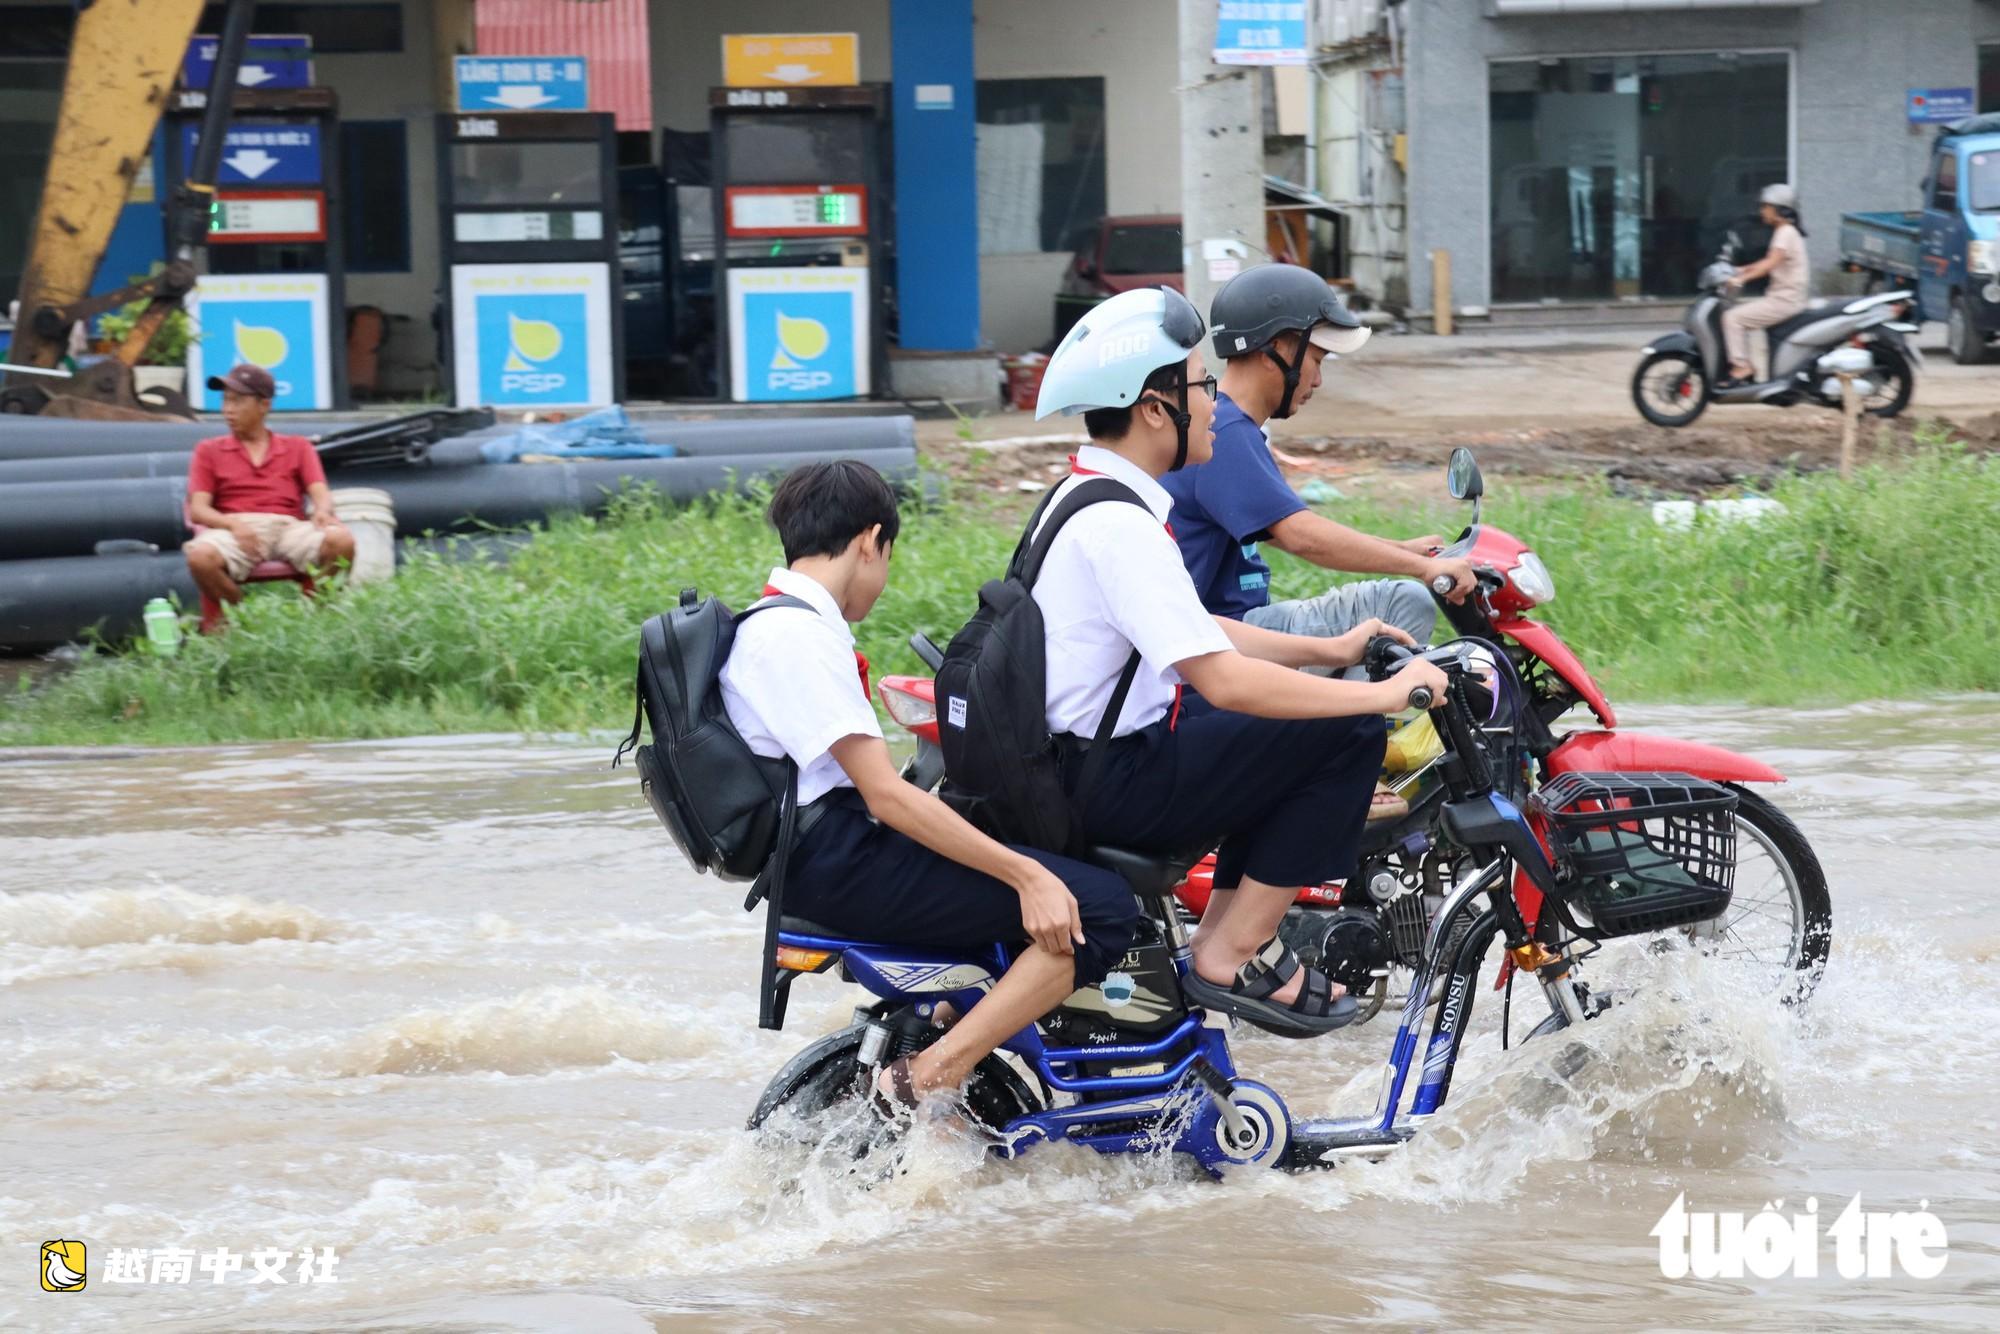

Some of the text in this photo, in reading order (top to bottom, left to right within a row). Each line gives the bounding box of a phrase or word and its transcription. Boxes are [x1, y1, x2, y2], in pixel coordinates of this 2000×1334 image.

[501, 374, 566, 393] PSP
[768, 371, 832, 391] PSP
[1440, 973, 1465, 1033] SONSU
[1081, 1046, 1116, 1055] Model
